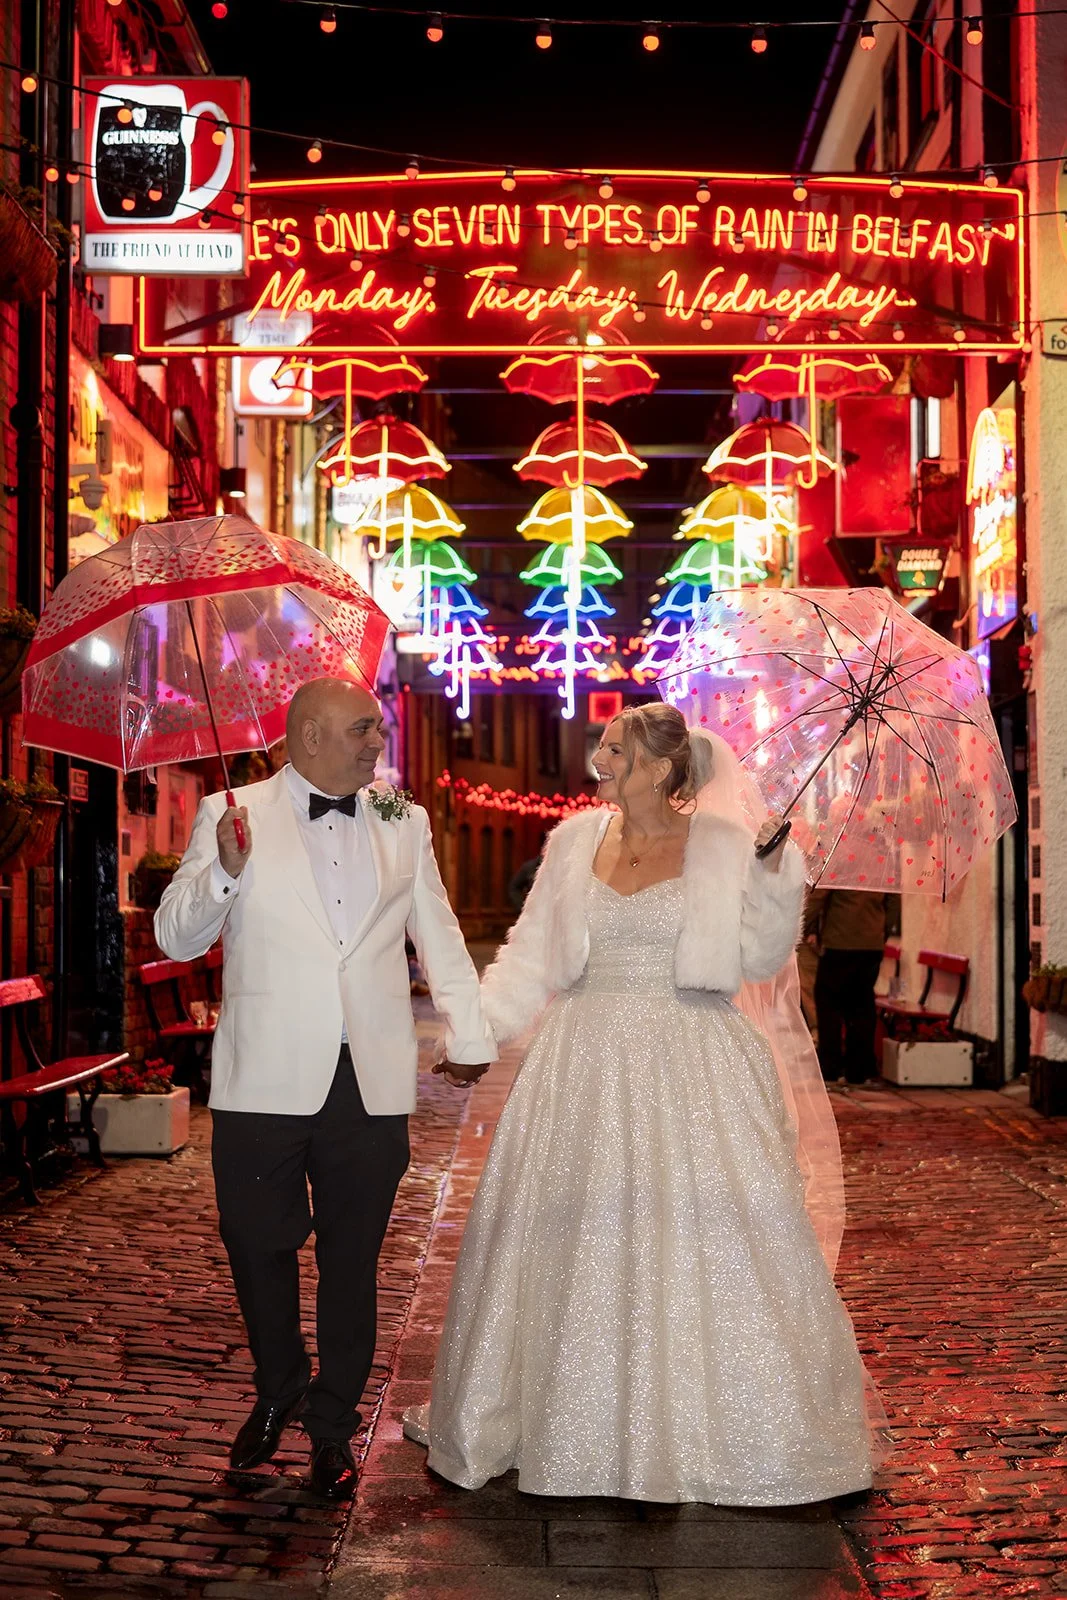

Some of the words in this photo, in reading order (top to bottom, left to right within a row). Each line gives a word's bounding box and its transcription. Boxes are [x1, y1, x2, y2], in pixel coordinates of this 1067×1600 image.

[102, 130, 179, 145] GUINNESS
[315, 209, 395, 254] ONLY
[413, 204, 520, 247] SEVEN
[536, 204, 645, 245] TYPES
[655, 205, 700, 245] OF
[714, 205, 794, 251] RAIN
[805, 211, 838, 253] IN
[92, 242, 118, 257] THE
[122, 243, 171, 258] FRIEND
[178, 244, 190, 258] AT
[196, 244, 233, 259] HAND
[901, 549, 940, 560] DOUBLE
[897, 559, 943, 571] DIAMOND
